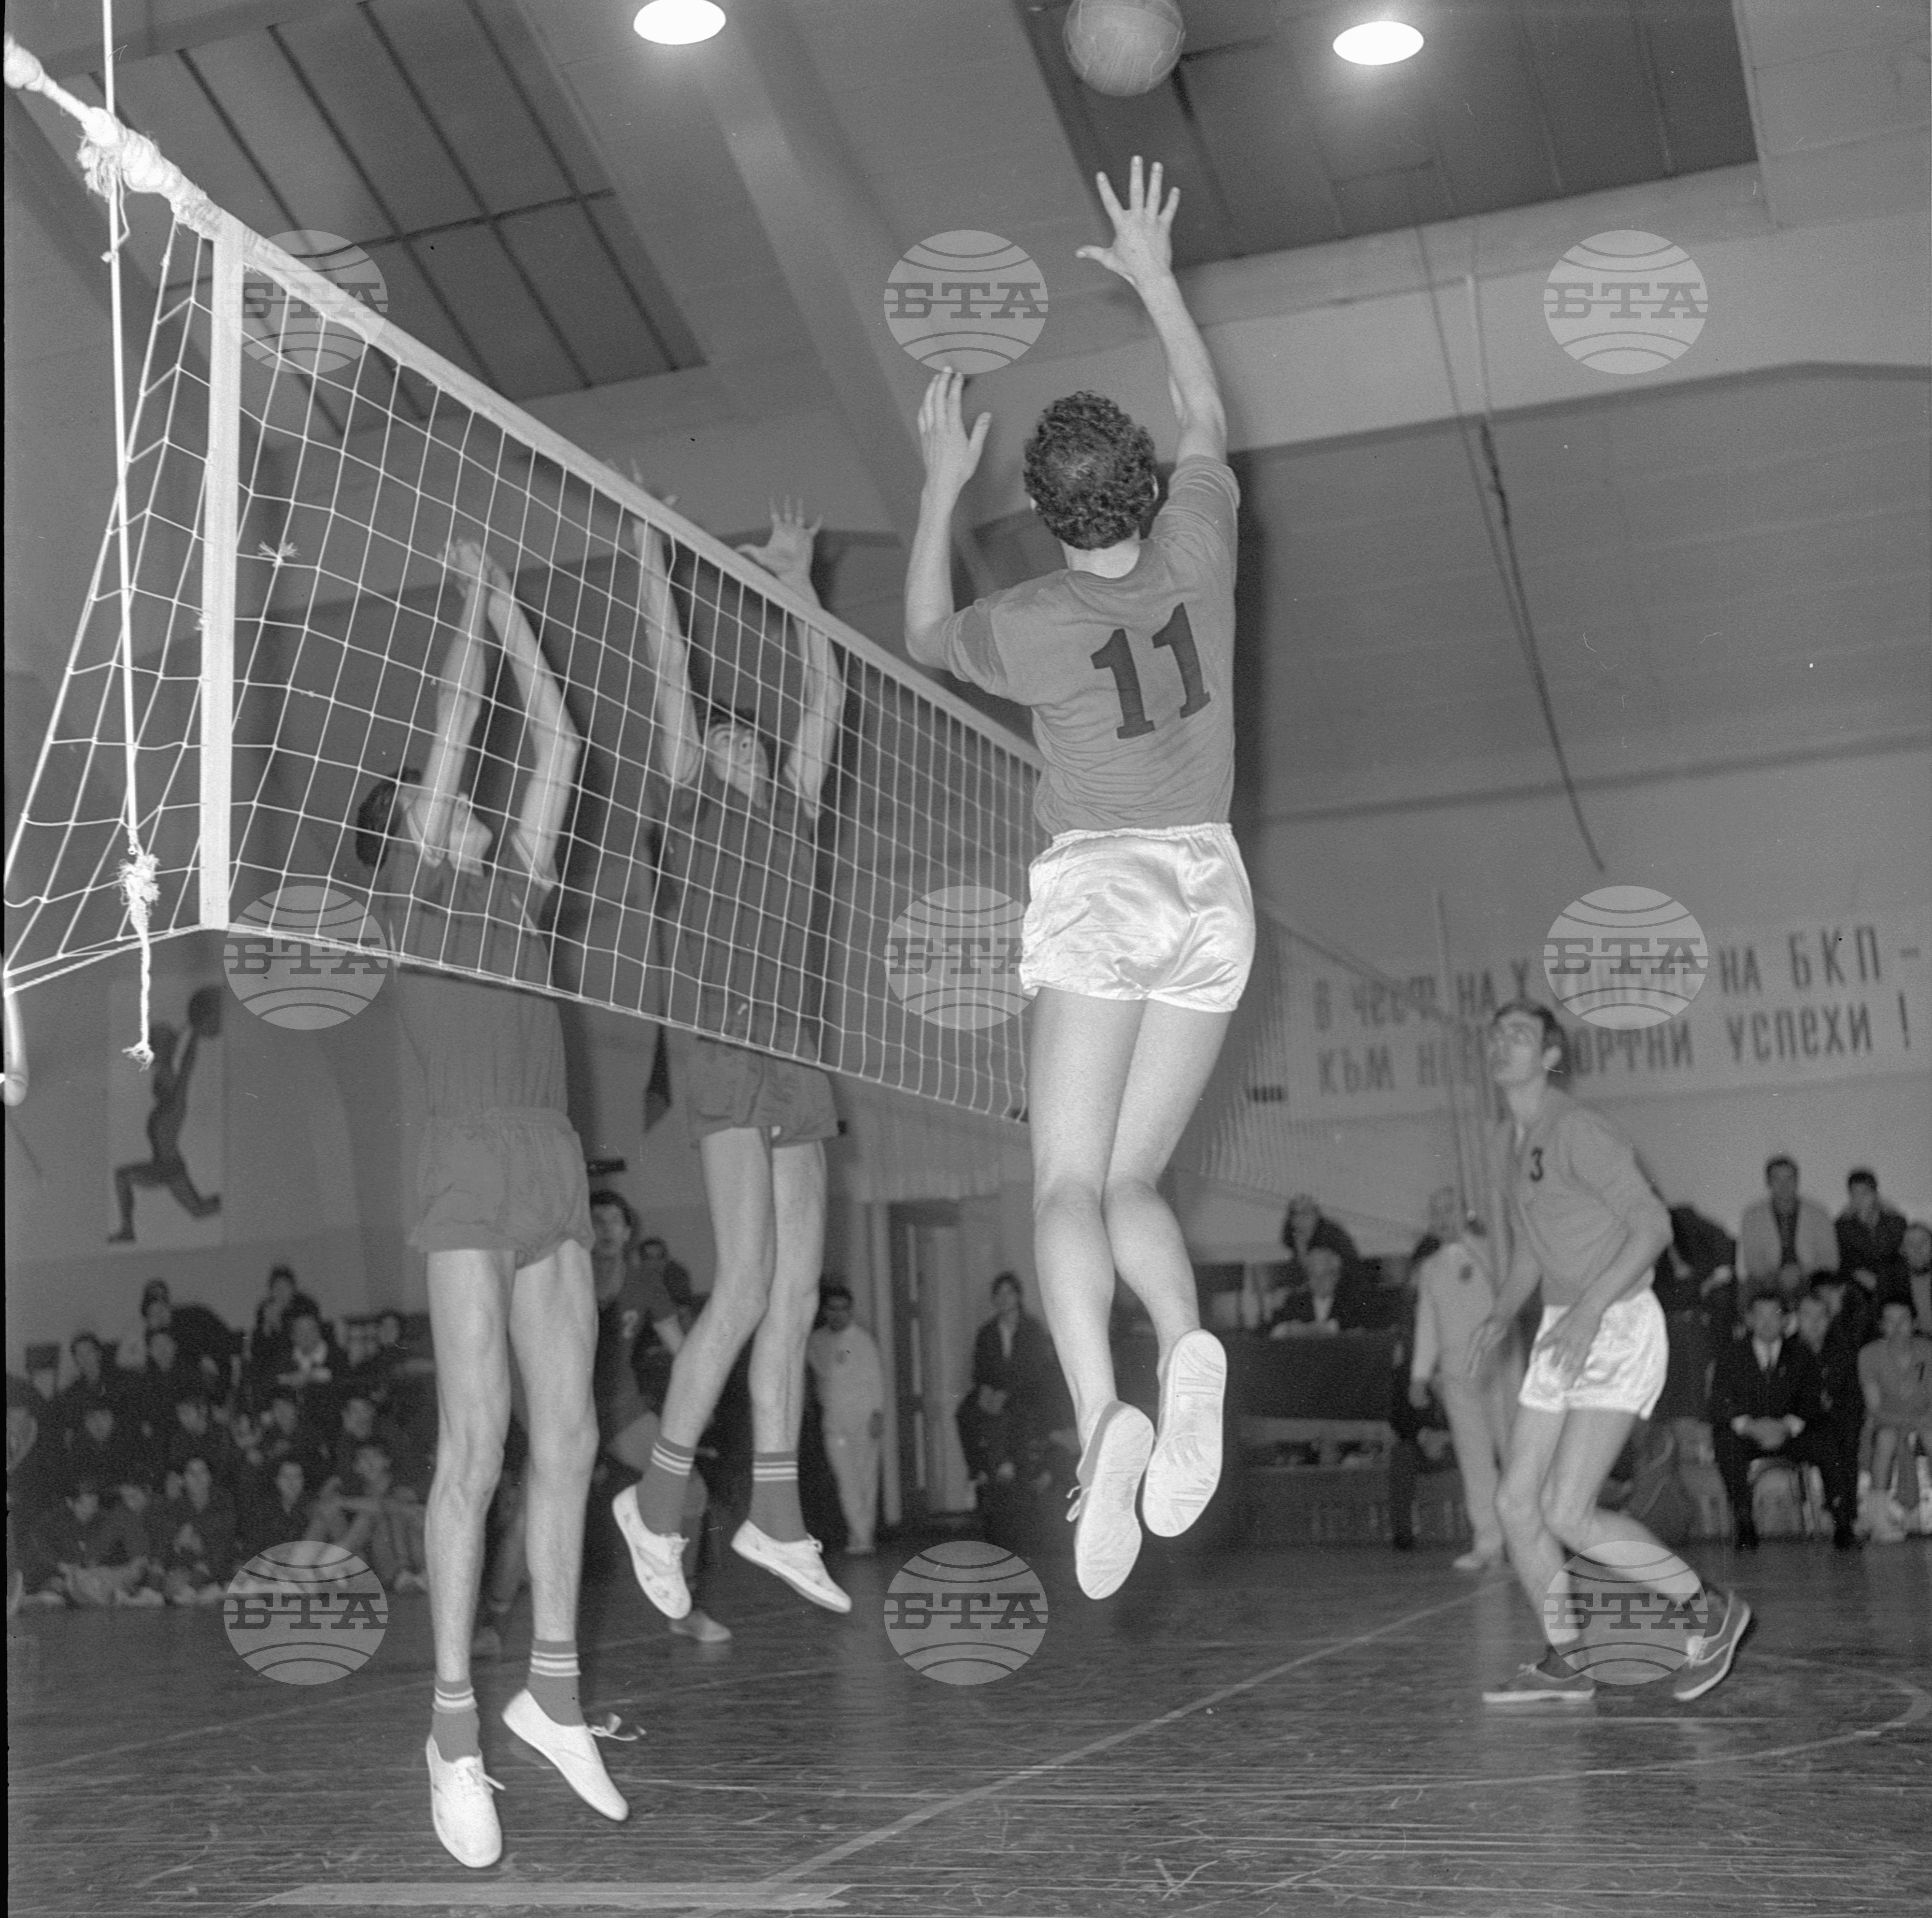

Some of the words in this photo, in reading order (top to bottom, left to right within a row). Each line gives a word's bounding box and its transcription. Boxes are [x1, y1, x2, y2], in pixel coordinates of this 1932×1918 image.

[1090, 602, 1211, 739] 11
[1718, 945, 1762, 994] НА
[1788, 924, 1881, 990] БКП
[1317, 1044, 1396, 1096] КЪМ
[1573, 1020, 1693, 1074] ОРТНИ
[1725, 1002, 1874, 1062] УСПЕХИ
[1529, 1147, 1544, 1183] 3
